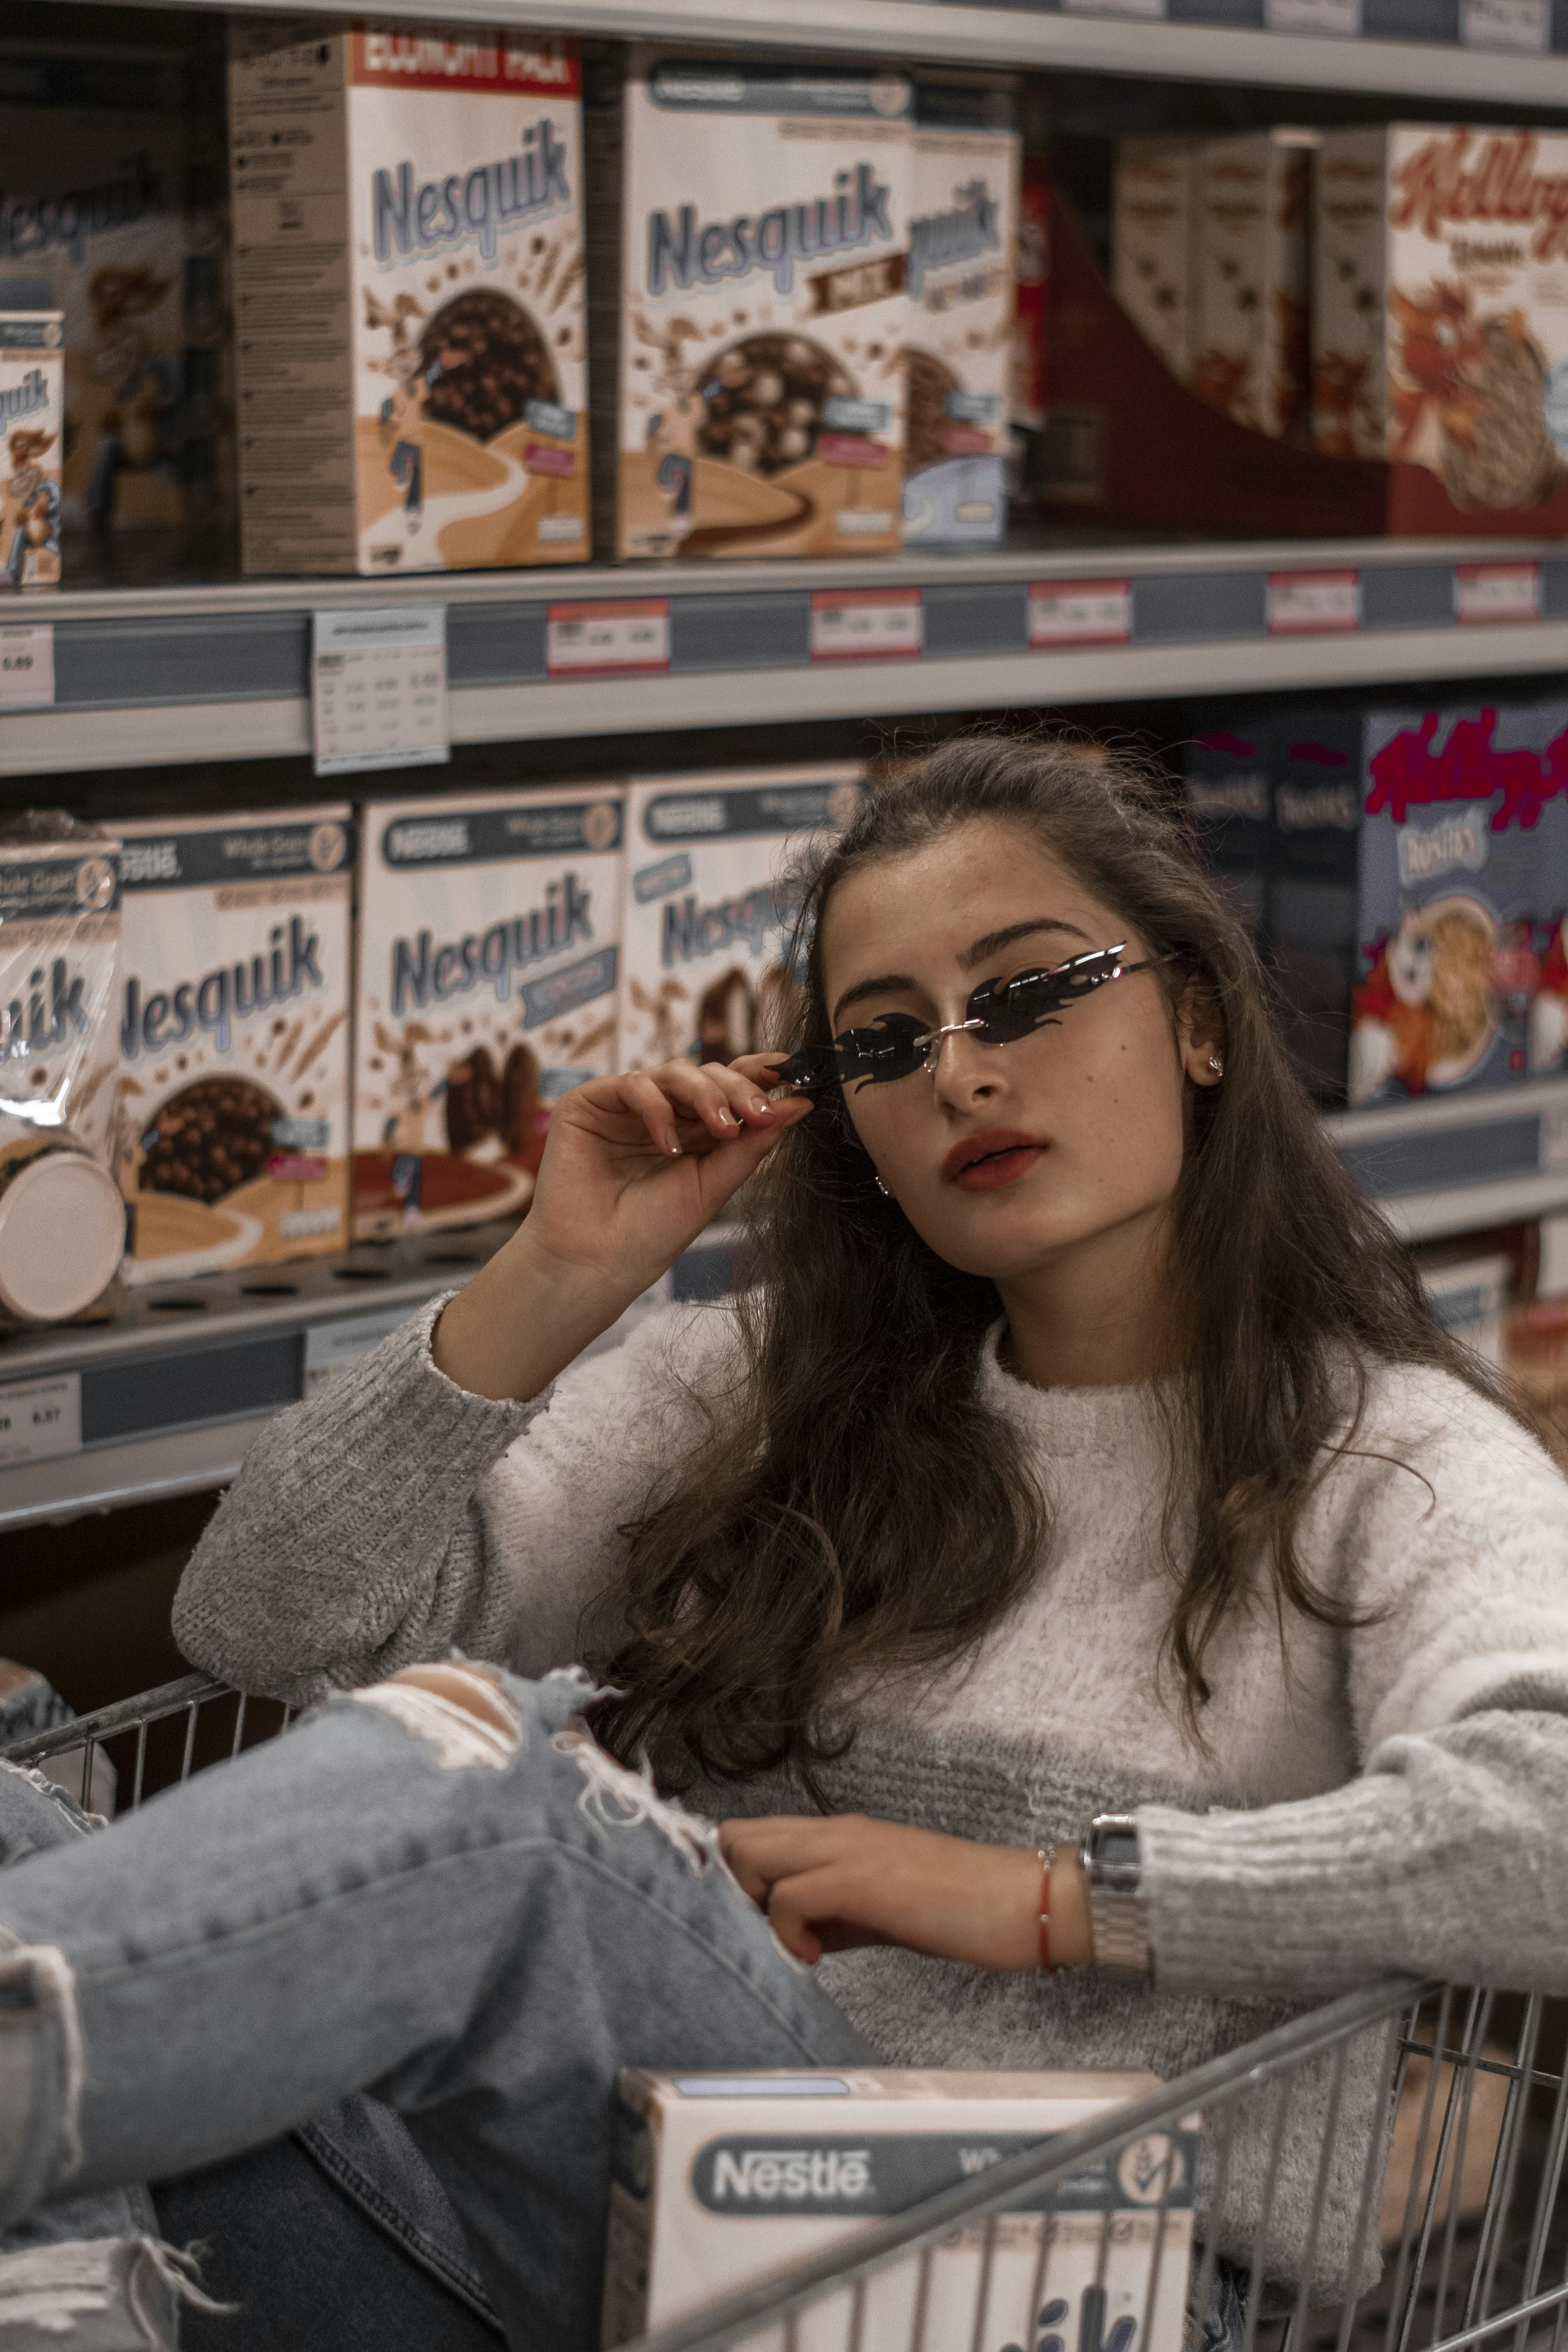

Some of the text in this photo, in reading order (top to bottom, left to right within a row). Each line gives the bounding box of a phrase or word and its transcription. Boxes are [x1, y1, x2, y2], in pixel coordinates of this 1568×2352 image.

[372, 118, 569, 262] Nesquik
[649, 162, 893, 295] Nesquik
[392, 871, 592, 1017] Nesquik
